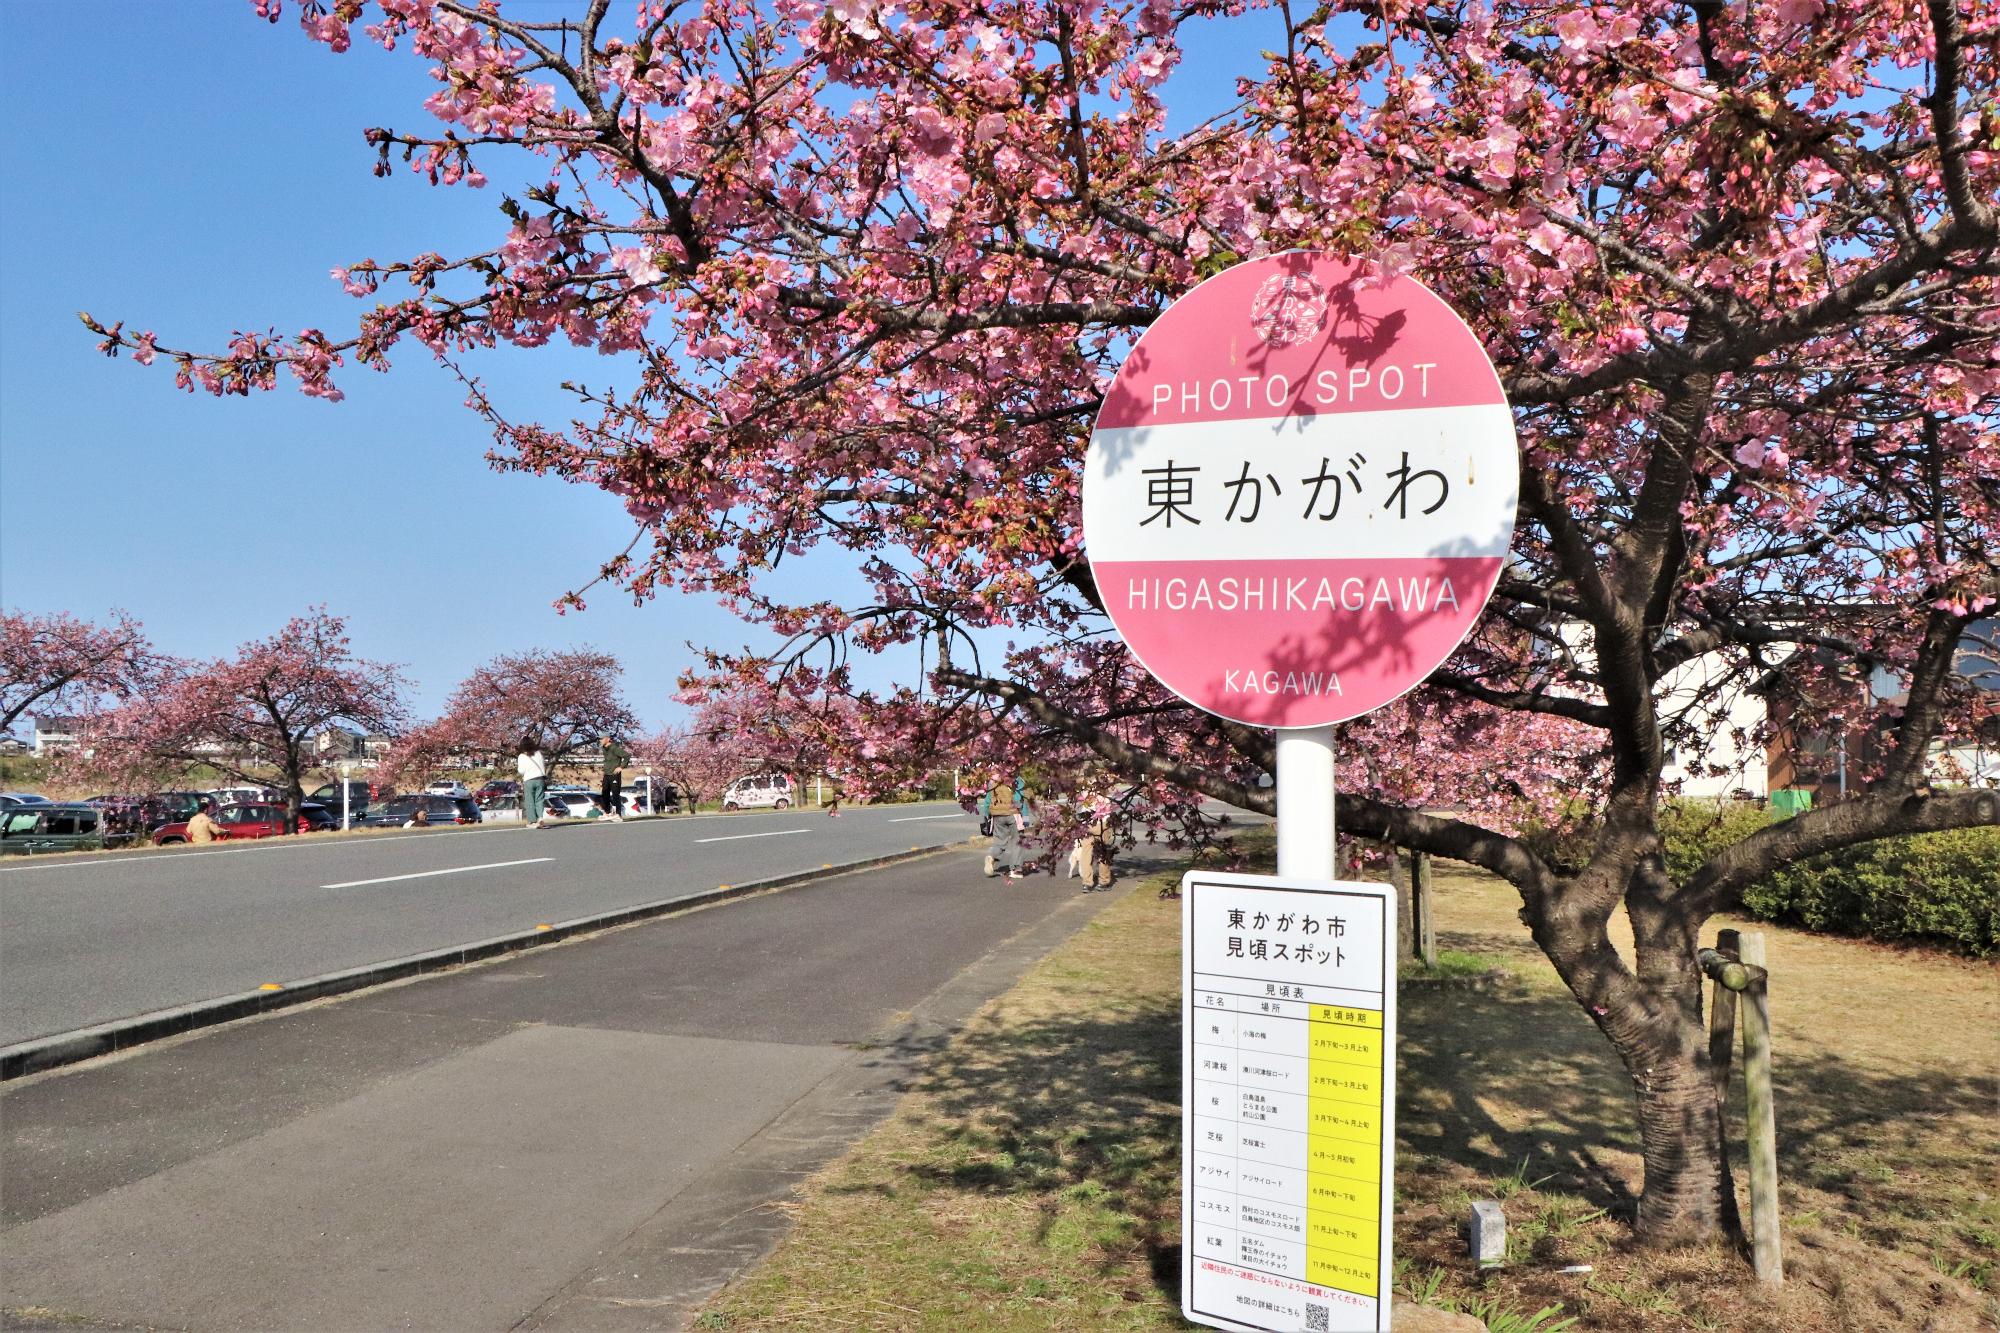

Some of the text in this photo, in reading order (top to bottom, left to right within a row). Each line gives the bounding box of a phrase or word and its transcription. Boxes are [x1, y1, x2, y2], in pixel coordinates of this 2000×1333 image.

[1281, 276, 1297, 343] 東かがわ
[1153, 363, 1437, 415] PHOTO SPOT
[1139, 451, 1450, 529] 東かがわ
[1128, 577, 1459, 612] HIGASHIKAGAWA
[1224, 669, 1342, 697] KAGAWA
[1227, 908, 1346, 938] 東かがわ市
[1226, 937, 1346, 967] 見頃スポット
[1265, 984, 1304, 999] 見頃表
[1206, 996, 1225, 1007] 花名
[1261, 1003, 1280, 1013] 場所
[1322, 1009, 1366, 1023] 見頃時期
[1204, 1060, 1228, 1071] 河津桜
[1208, 1131, 1223, 1142] 芝桜
[1200, 1166, 1231, 1179] アジサイ
[1242, 1175, 1283, 1187] アジサイロード
[1200, 1201, 1231, 1213] コスモス
[1207, 1236, 1222, 1247] 紅葉
[1236, 1295, 1301, 1317] 地図の詳細はこちら
